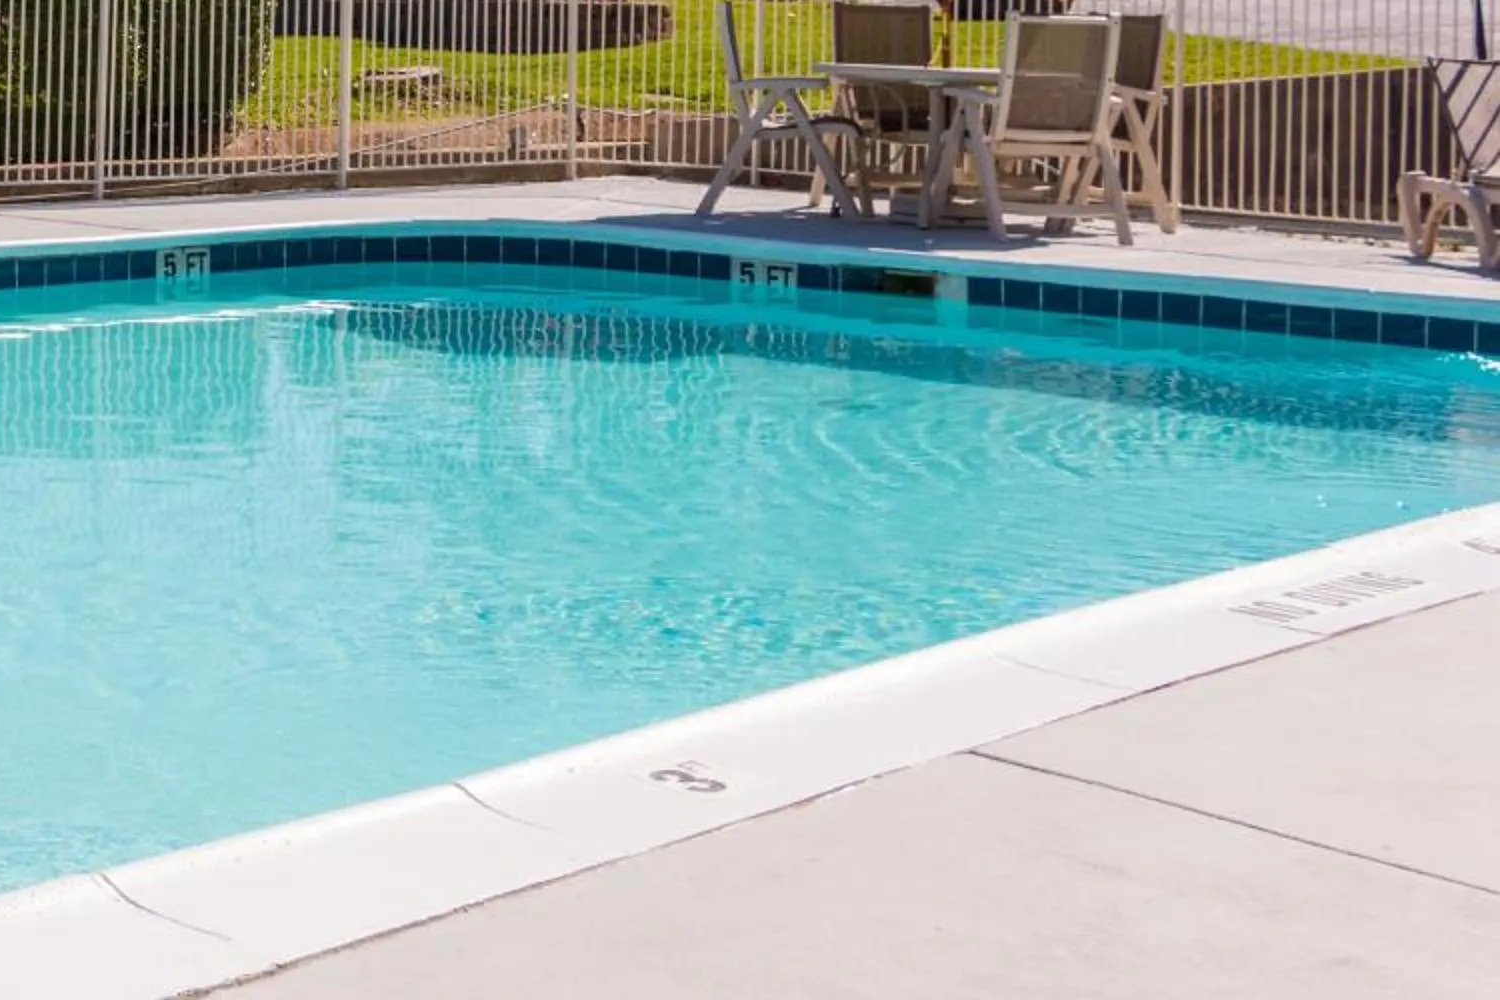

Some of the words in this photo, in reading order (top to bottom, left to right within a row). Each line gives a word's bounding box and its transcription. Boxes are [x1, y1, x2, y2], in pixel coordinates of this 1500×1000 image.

[164, 252, 177, 276] 5
[185, 251, 207, 277] FT
[740, 262, 755, 285] 5
[768, 265, 794, 288] FT
[1227, 600, 1320, 623] NO
[1282, 571, 1426, 607] DIVING
[648, 769, 727, 793] 3
